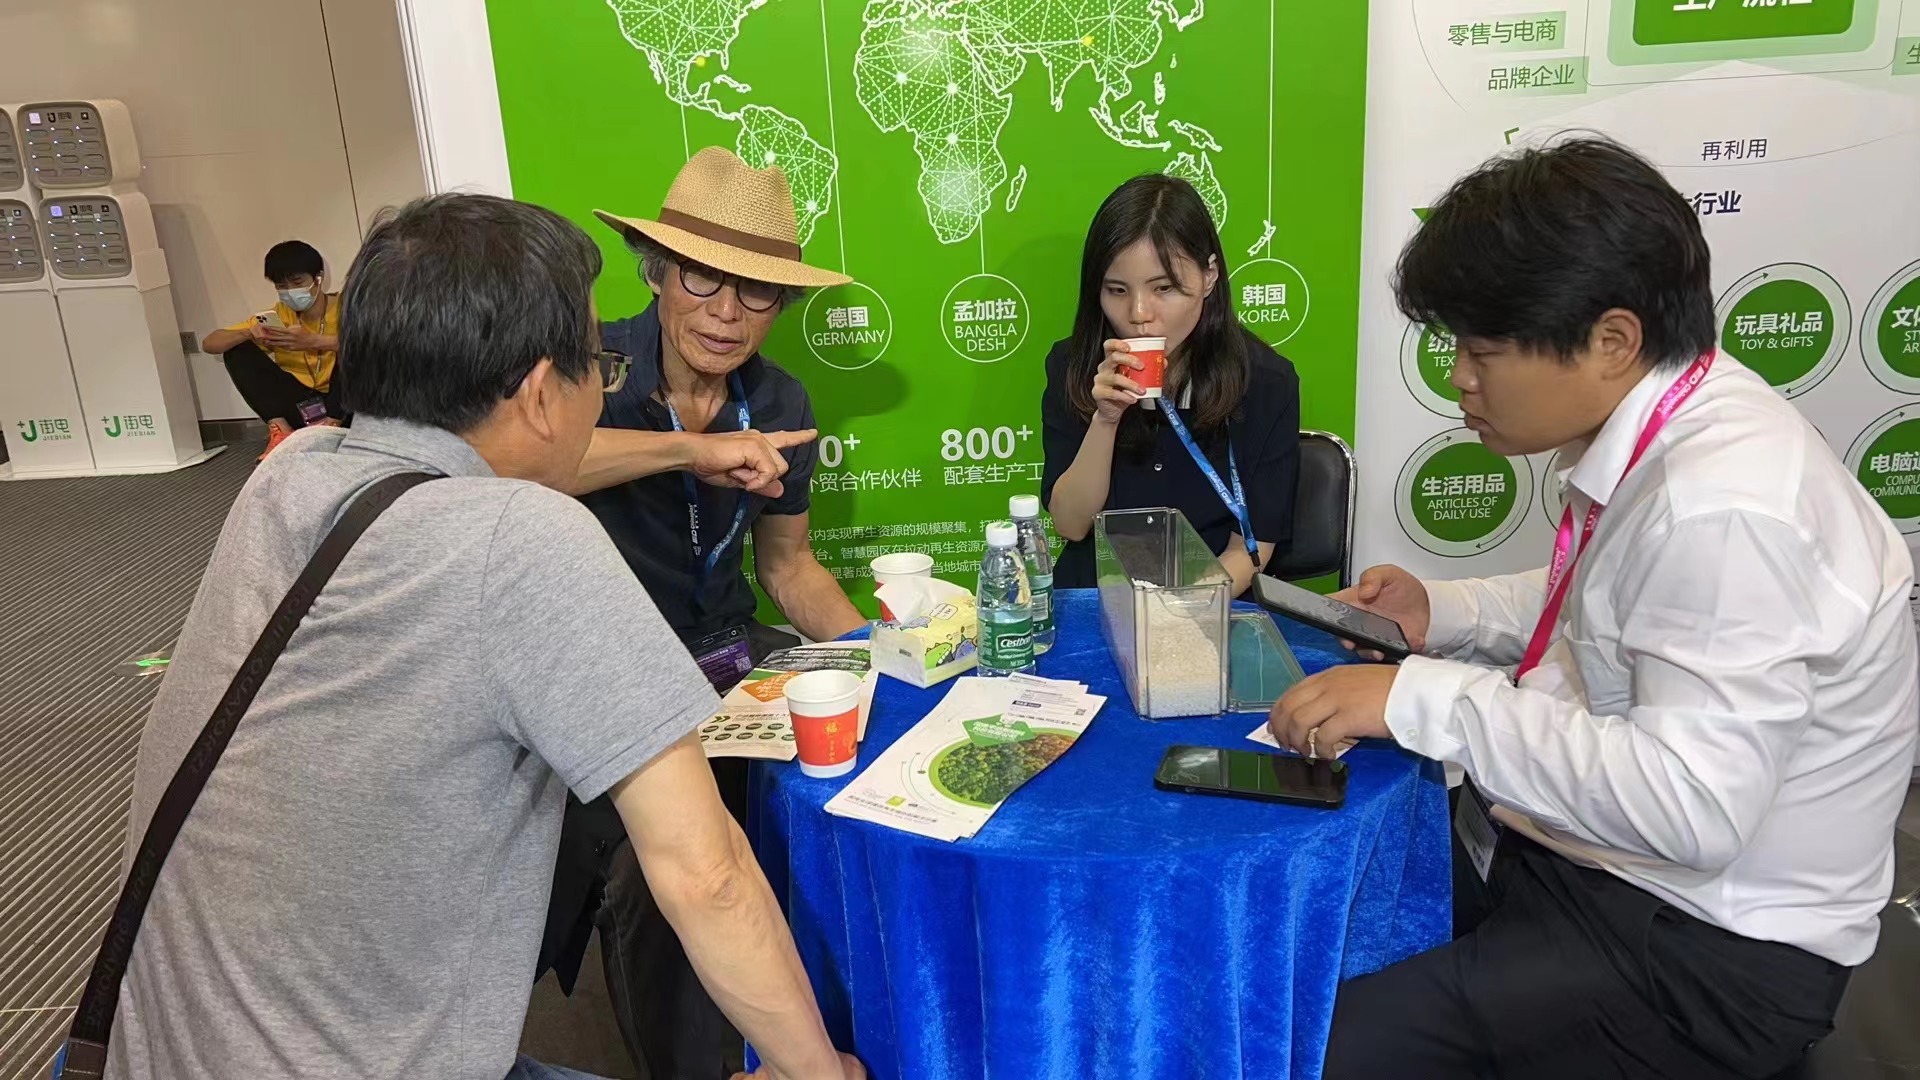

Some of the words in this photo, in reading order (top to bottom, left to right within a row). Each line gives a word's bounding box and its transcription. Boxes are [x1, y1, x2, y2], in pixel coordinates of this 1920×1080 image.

[1448, 19, 1558, 46] 零售与电商
[1488, 64, 1574, 90] 品牌企业
[1701, 139, 1767, 161] 再利用
[1680, 190, 1742, 215] 行业
[1242, 284, 1286, 307] 韩国
[826, 306, 869, 329] 德国
[953, 298, 1018, 322] 孟加拉
[1238, 308, 1290, 323] KOREA
[955, 323, 1017, 338] BANGLA
[1734, 311, 1823, 336] 玩具礼品
[812, 330, 885, 346] GERMANY
[966, 338, 1006, 352] DESH
[1740, 338, 1765, 350] TOY
[1767, 338, 1778, 348] &
[1780, 336, 1814, 348] GIFTS
[1904, 330, 1920, 341] ST
[941, 424, 1033, 461] 800+
[944, 462, 1044, 486] 配套生产工
[1422, 473, 1505, 496] 生活用品
[1427, 498, 1479, 510] ARTICLES
[1482, 496, 1498, 506] OF
[1434, 509, 1467, 520] DAILY
[1469, 508, 1491, 519] USE
